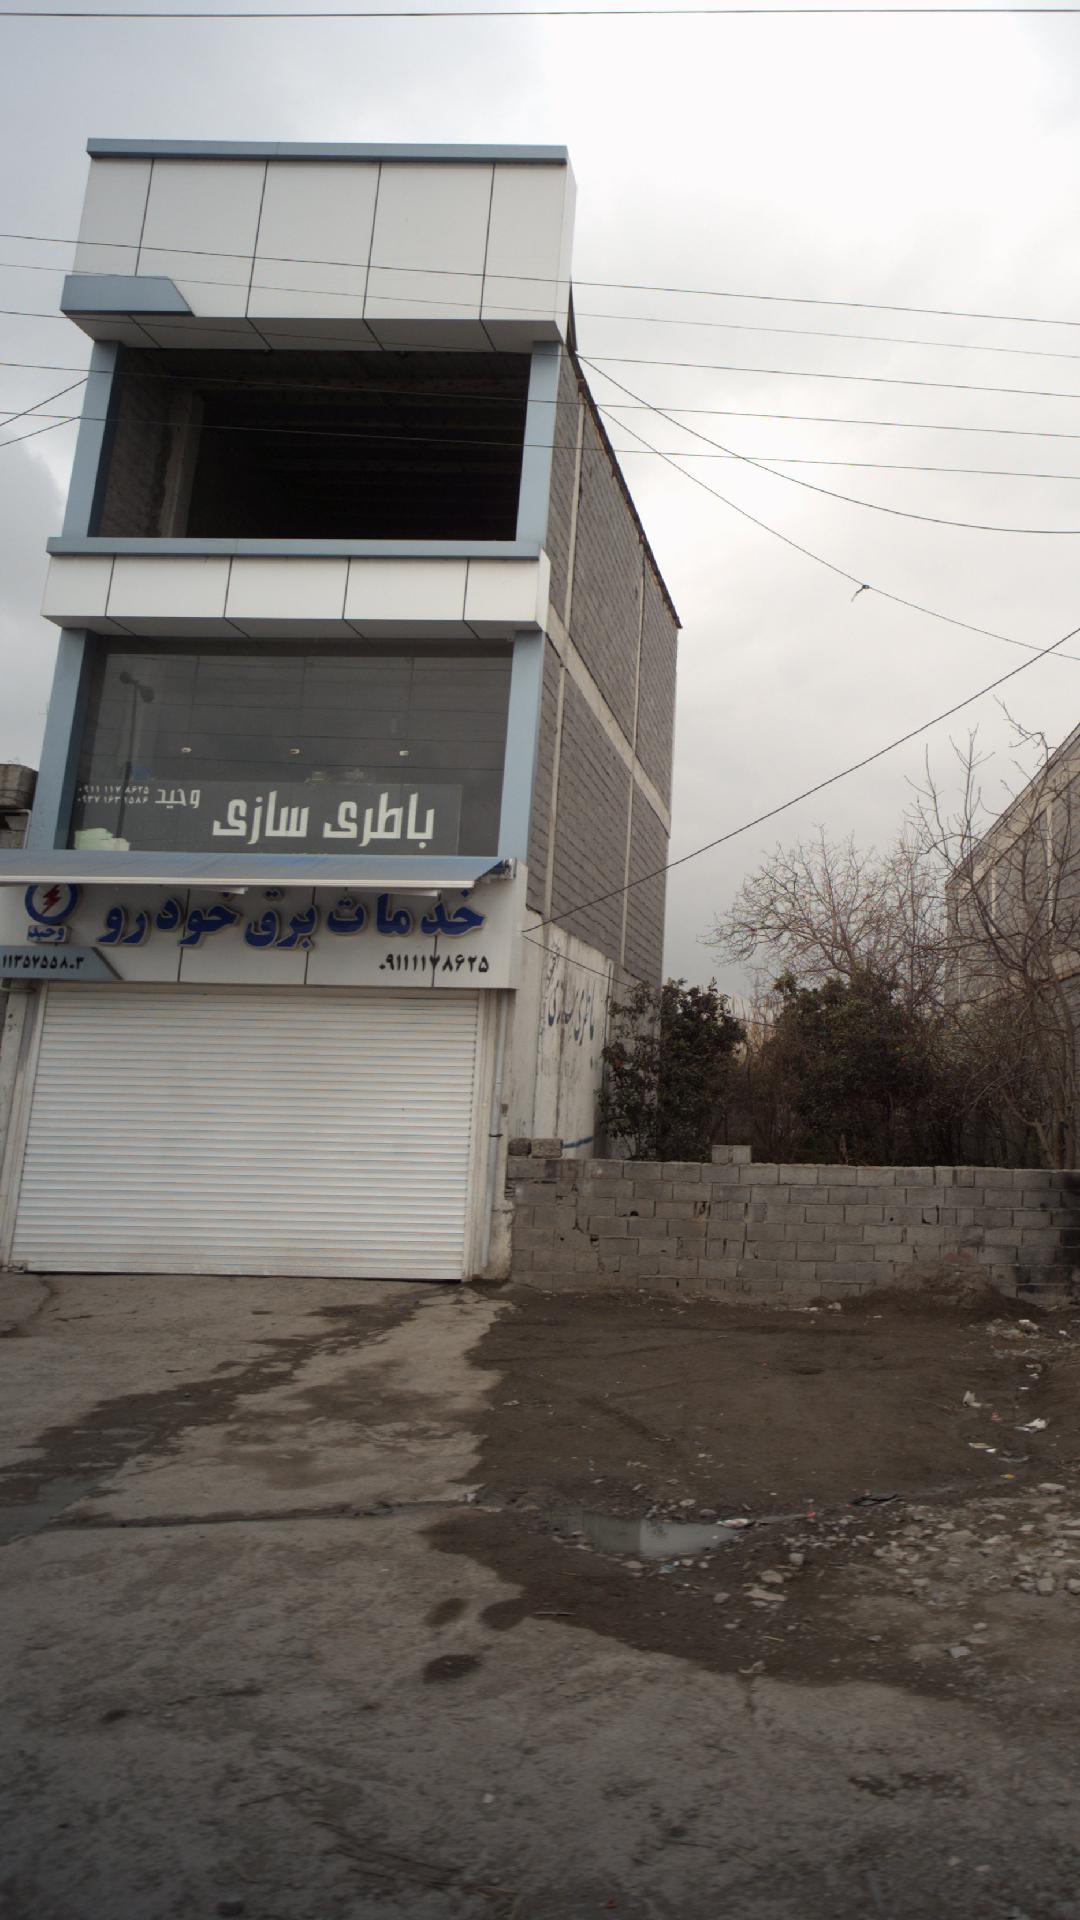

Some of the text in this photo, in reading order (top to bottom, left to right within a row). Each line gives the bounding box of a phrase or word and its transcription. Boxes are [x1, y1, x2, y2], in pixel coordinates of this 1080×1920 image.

[154, 788, 201, 809] وحید
[212, 789, 435, 849] باطری سازی
[96, 887, 487, 949] خدمات برق خودرو
[379, 953, 490, 973] ۰۹۱۱۱۱۷۸۶۲۵
